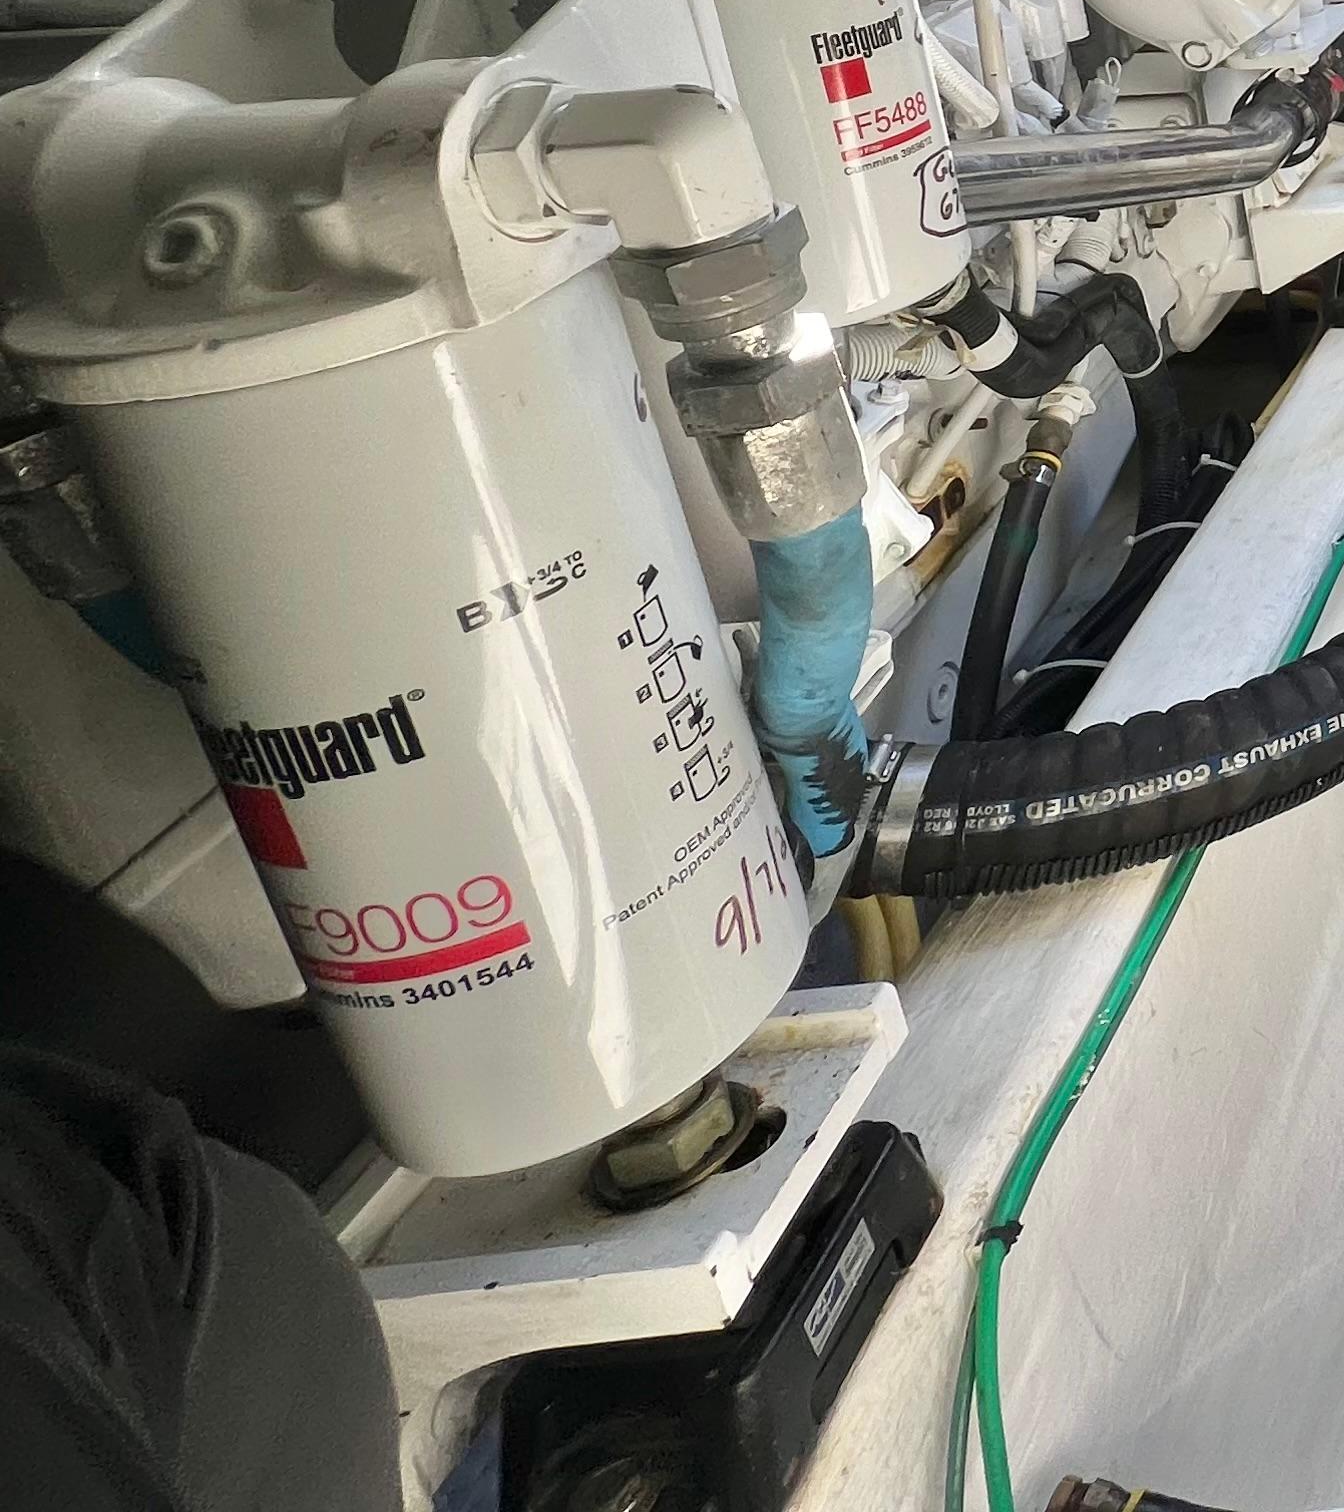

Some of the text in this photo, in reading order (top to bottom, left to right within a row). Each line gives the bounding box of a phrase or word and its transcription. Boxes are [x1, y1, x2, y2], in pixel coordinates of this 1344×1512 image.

[810, 12, 903, 64] Fleetguard
[833, 91, 928, 146] FF5488
[1219, 723, 1323, 776] EXHAUST
[601, 884, 665, 931] Patent
[666, 823, 733, 893] Approved
[401, 952, 536, 1006] 3401544
